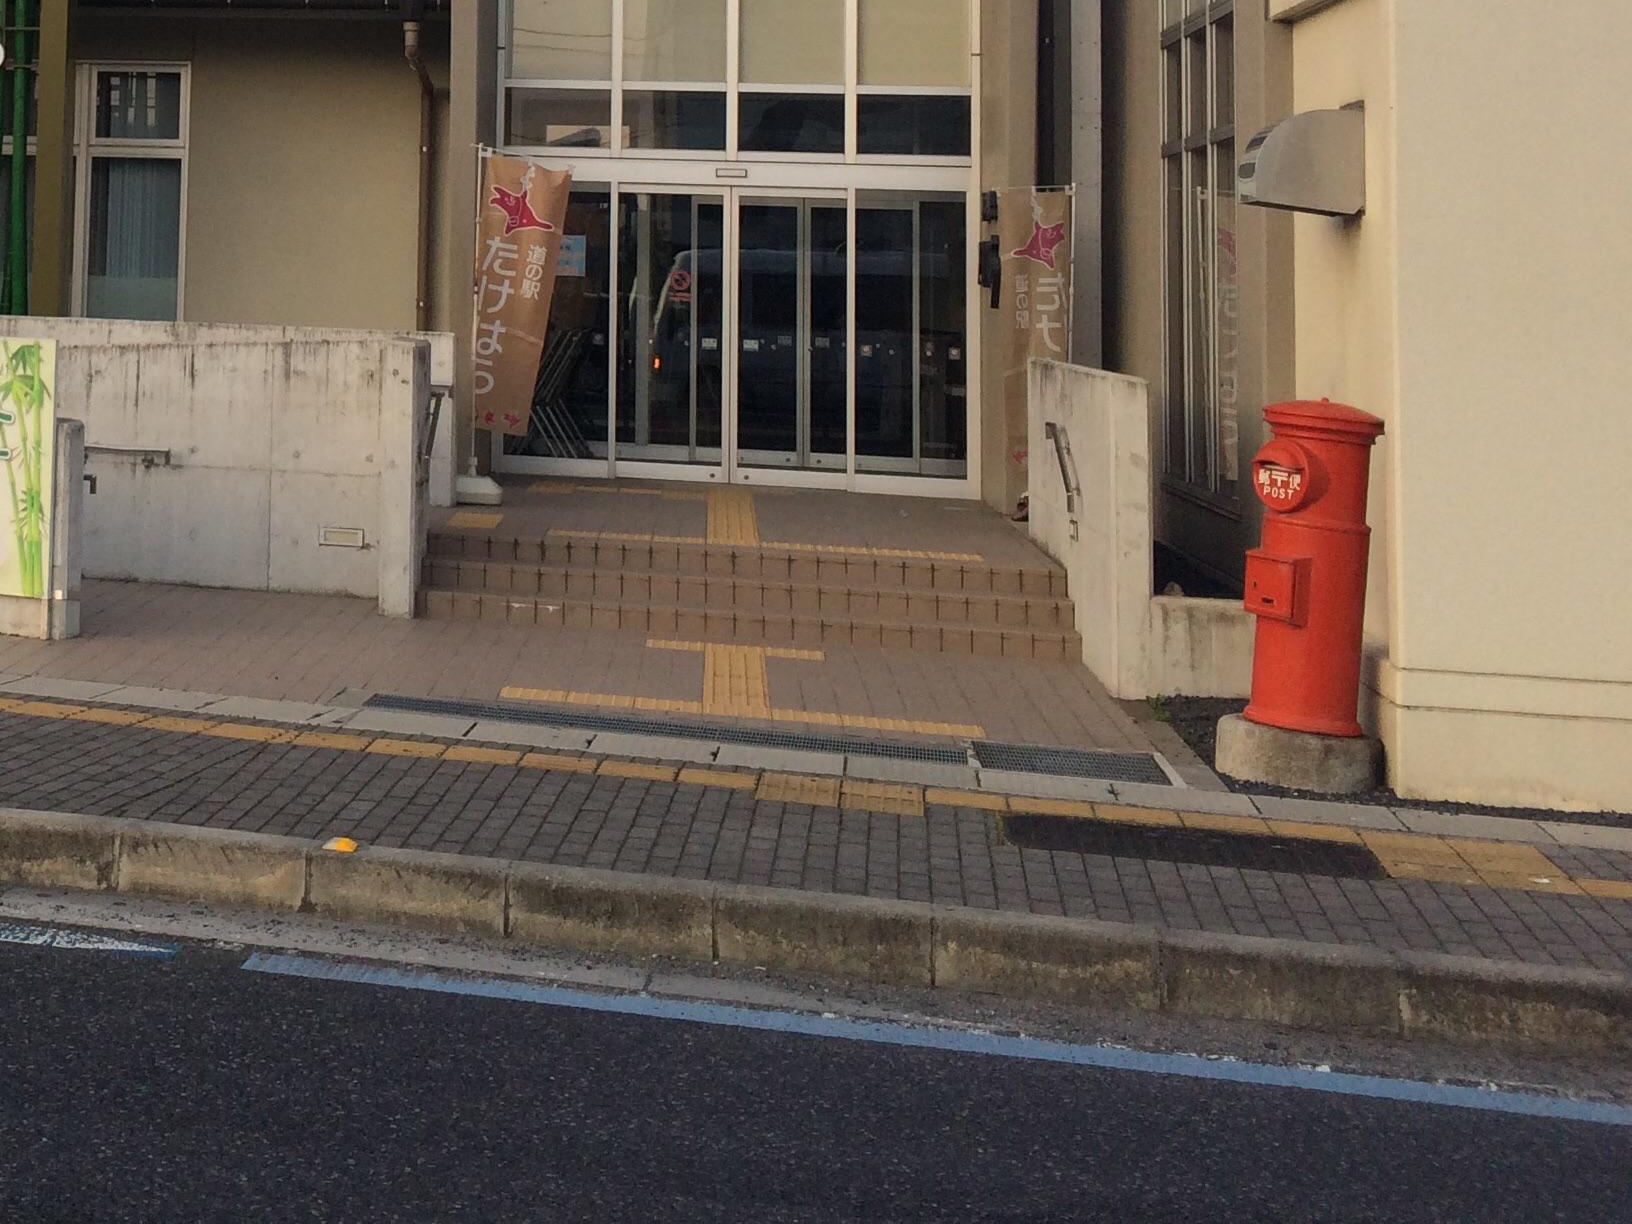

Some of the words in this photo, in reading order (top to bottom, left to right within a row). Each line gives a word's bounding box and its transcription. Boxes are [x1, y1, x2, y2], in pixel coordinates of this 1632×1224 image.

[521, 243, 548, 300] 道の駅
[473, 236, 519, 395] たけはら
[1263, 485, 1295, 501] POST
